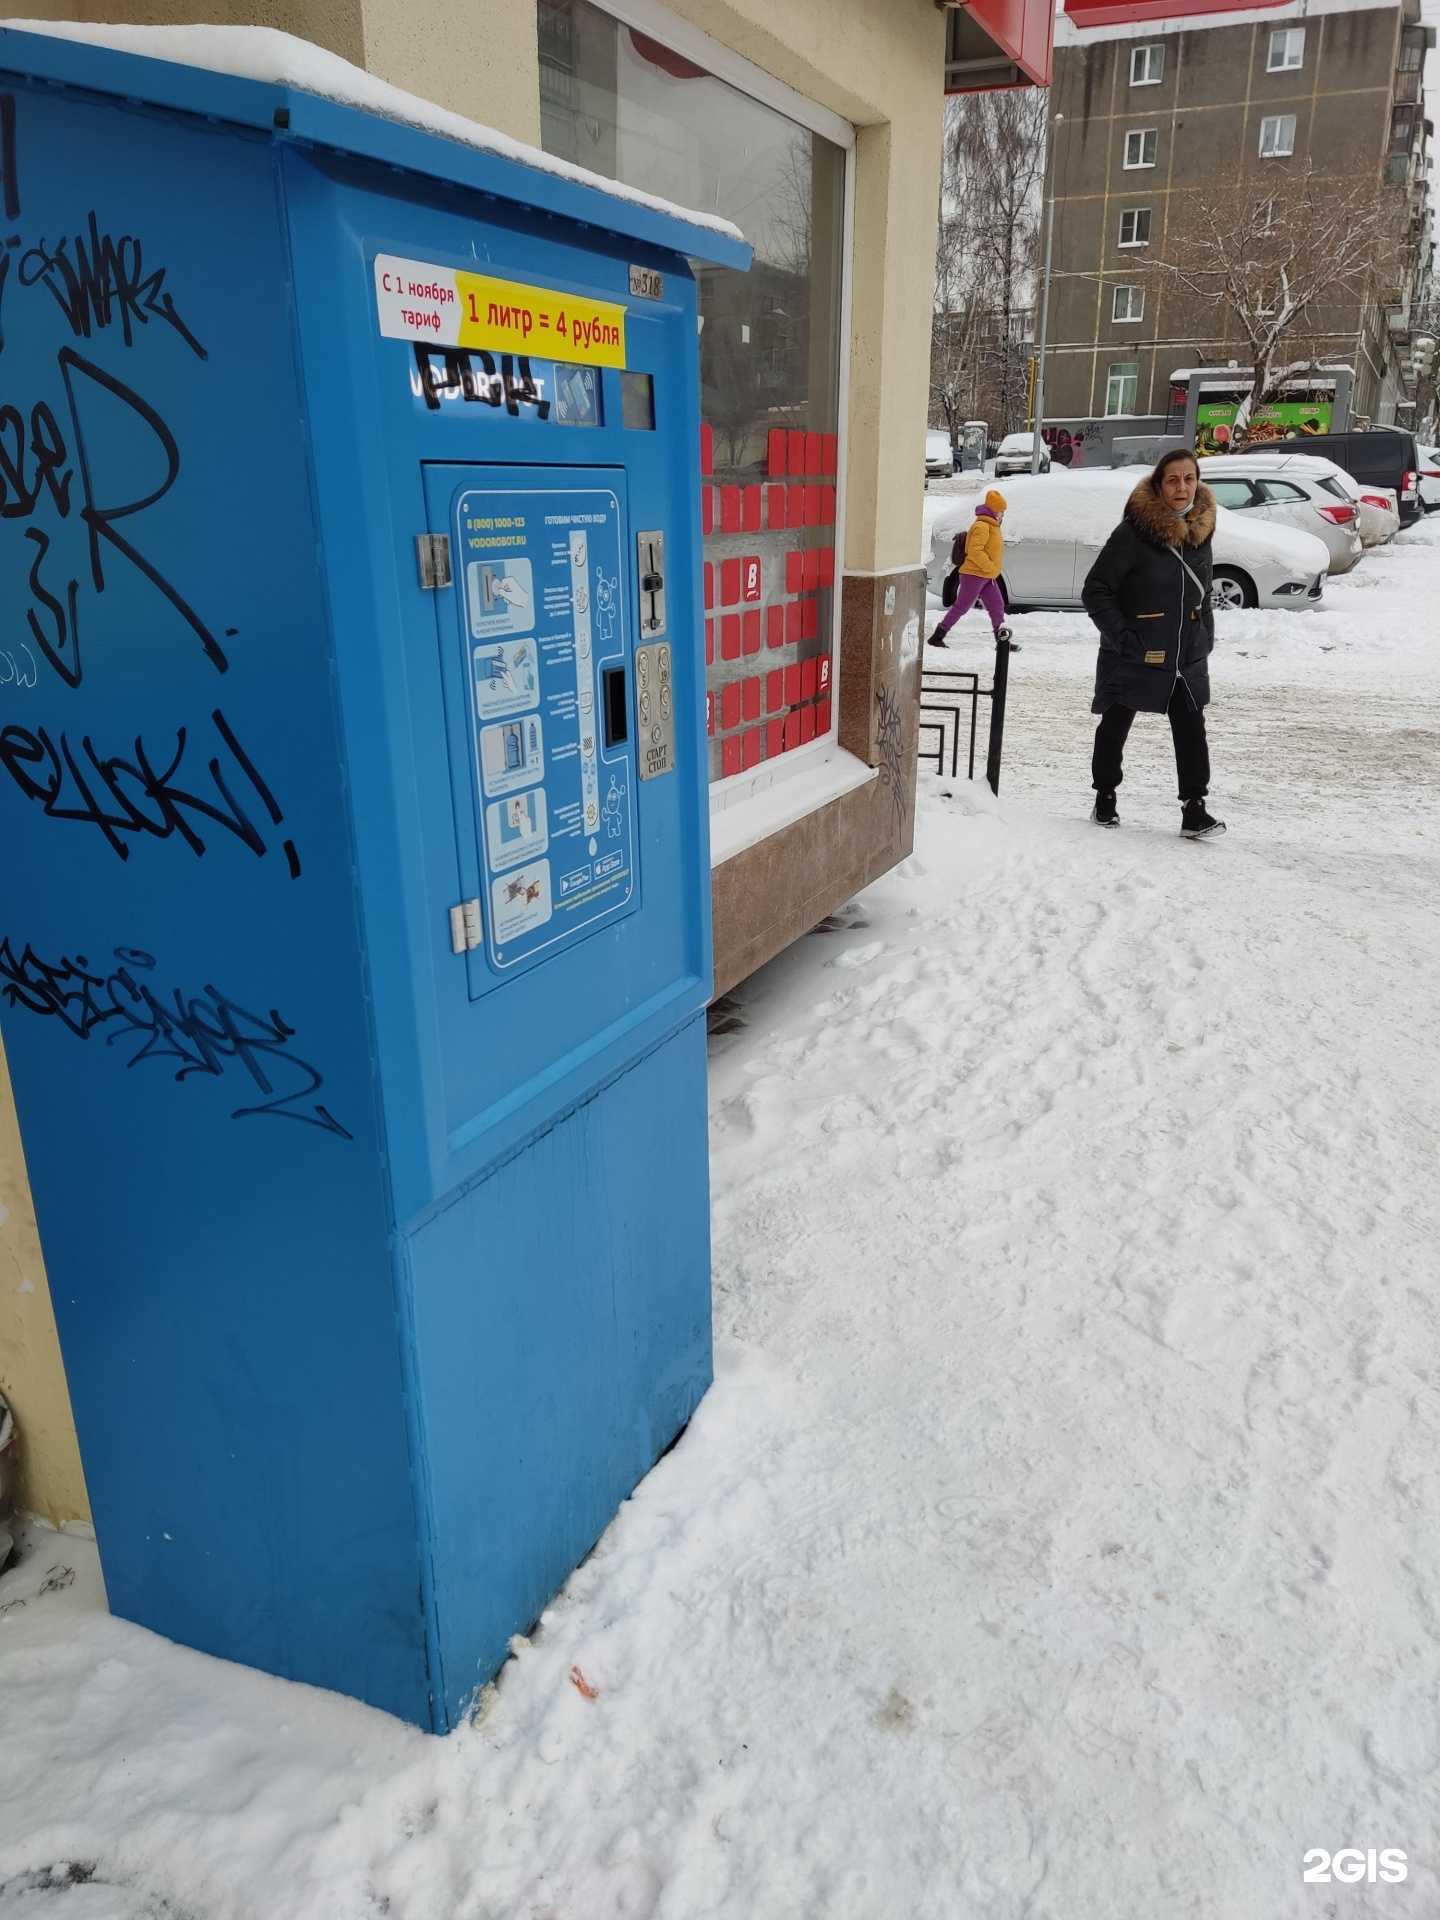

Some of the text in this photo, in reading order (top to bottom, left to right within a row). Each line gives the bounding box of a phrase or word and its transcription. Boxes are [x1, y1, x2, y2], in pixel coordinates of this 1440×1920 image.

[382, 273, 454, 304] С 1 ноября
[401, 309, 441, 332] тариф
[468, 293, 620, 349] 1 литр = 4 рубля
[468, 535, 527, 549] VODOROBOT.RU
[646, 744, 667, 761] СТАРТ
[648, 757, 666, 773] СТОП
